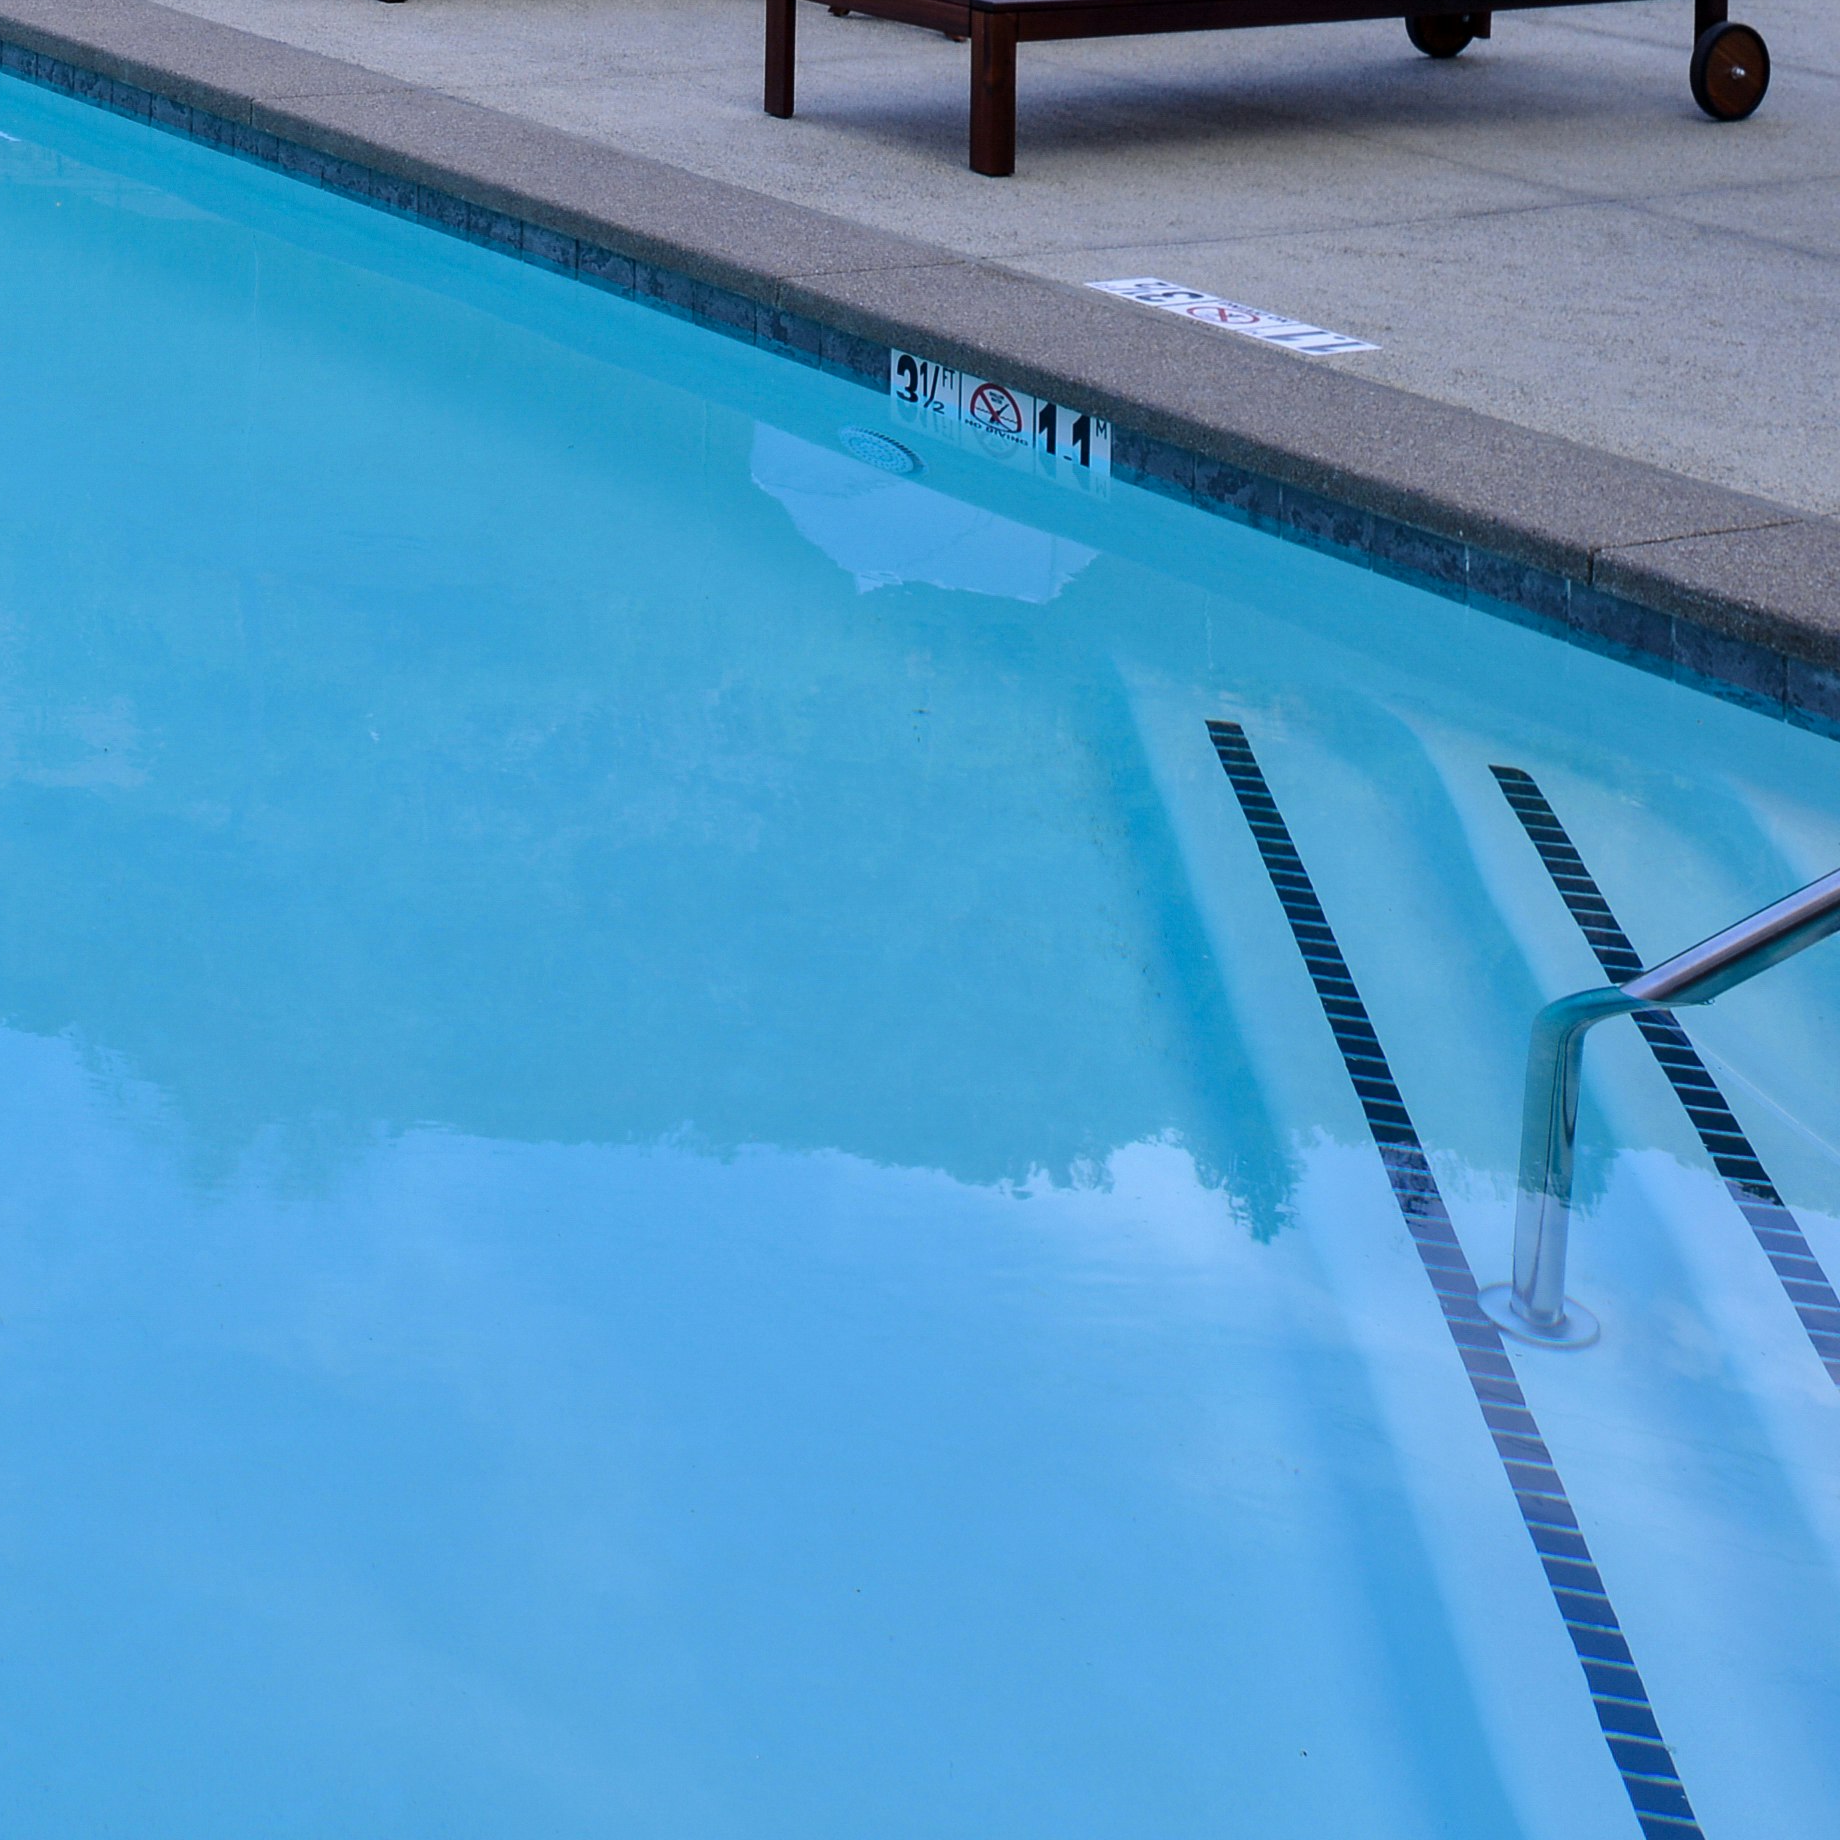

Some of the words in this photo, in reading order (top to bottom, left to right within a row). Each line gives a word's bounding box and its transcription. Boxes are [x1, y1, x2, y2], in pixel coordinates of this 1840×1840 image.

[942, 367, 955, 390] FT
[965, 419, 981, 429] NO
[986, 426, 1028, 446] DIVING
[1096, 418, 1107, 440] M
